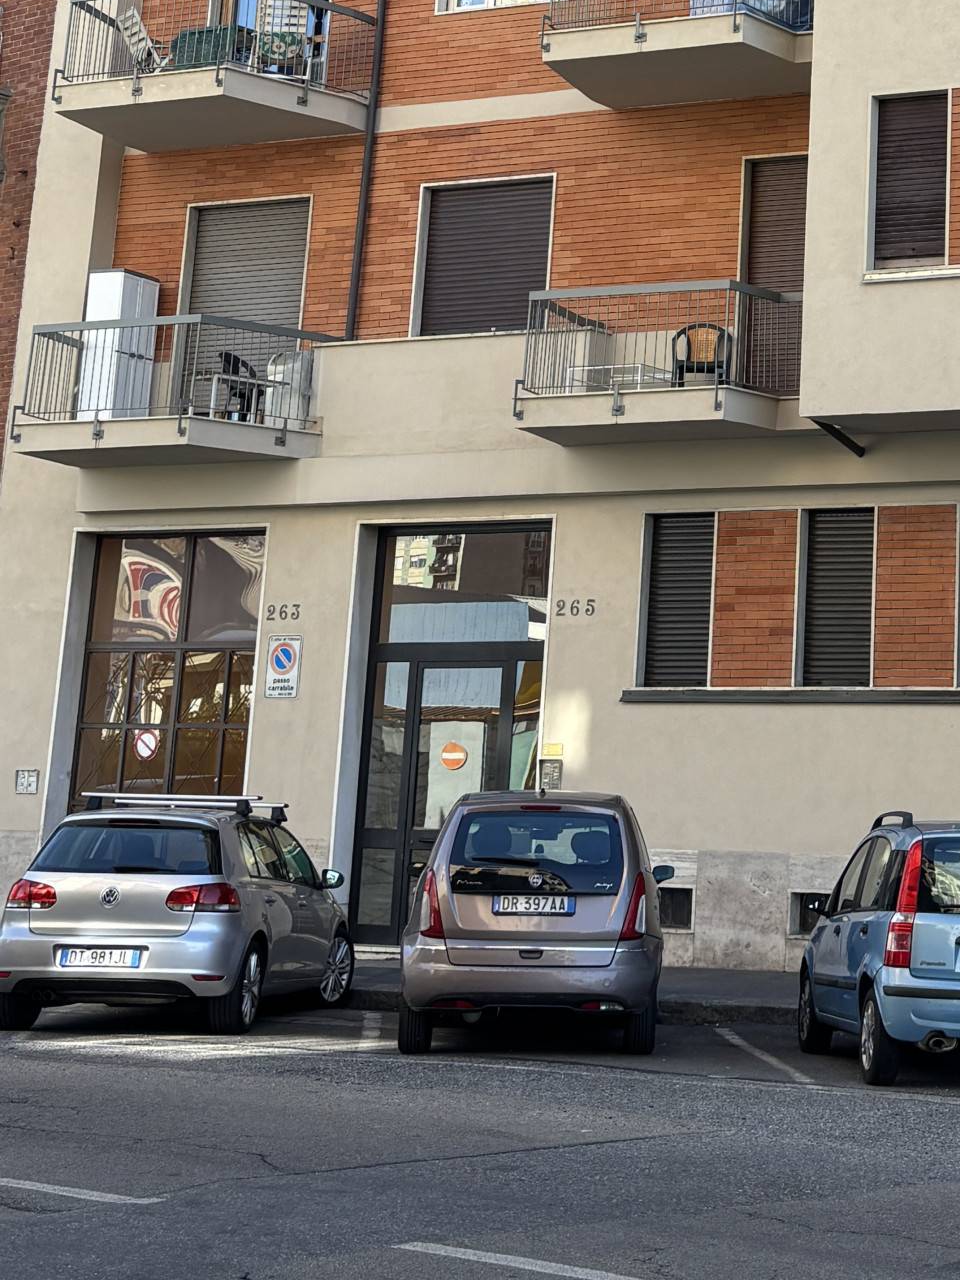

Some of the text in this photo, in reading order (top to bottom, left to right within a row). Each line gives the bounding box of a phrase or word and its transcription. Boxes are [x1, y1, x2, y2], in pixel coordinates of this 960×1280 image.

[266, 604, 301, 621] 263
[556, 599, 596, 617] 265
[502, 896, 566, 911] DR 397AA
[69, 950, 87, 963] DT
